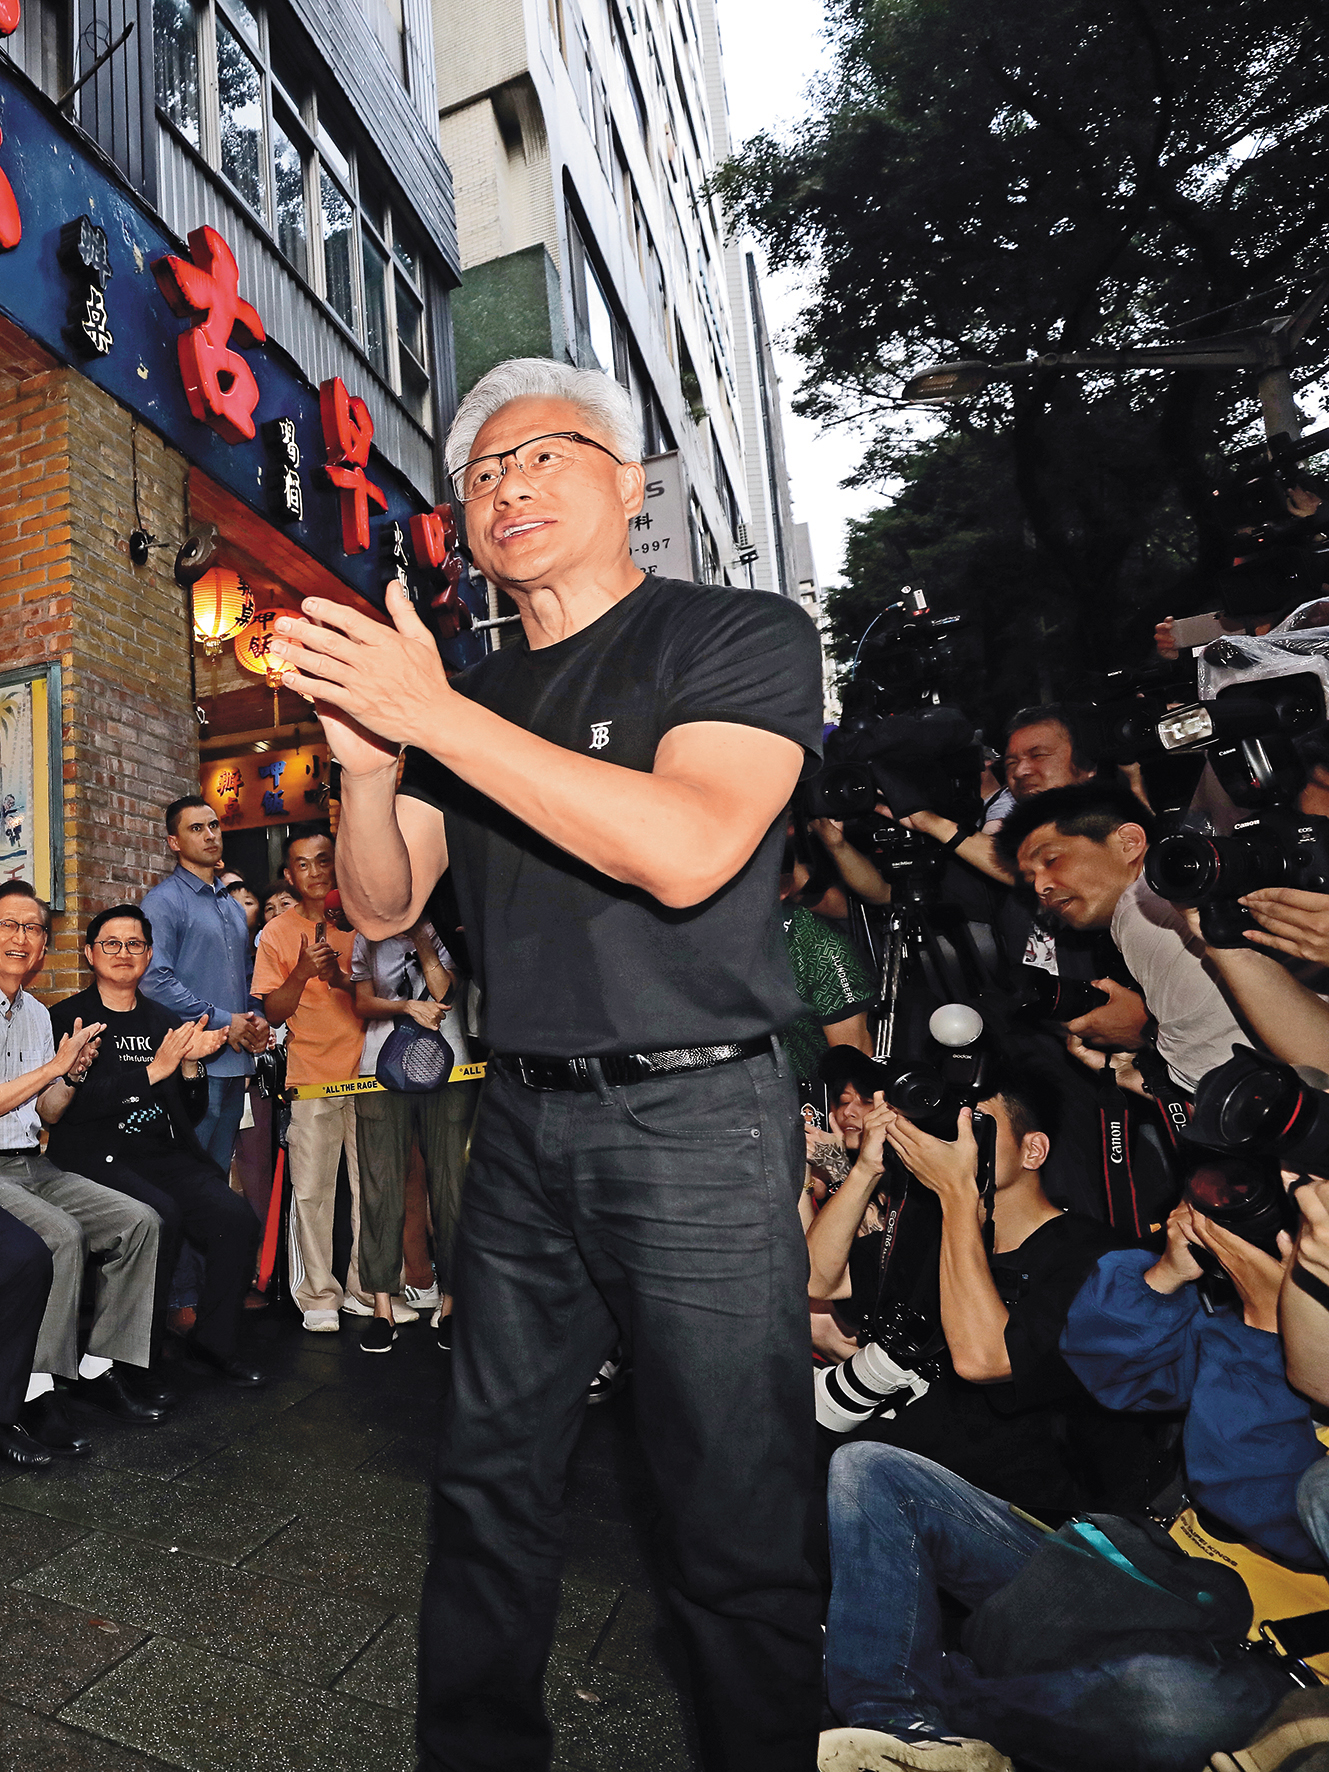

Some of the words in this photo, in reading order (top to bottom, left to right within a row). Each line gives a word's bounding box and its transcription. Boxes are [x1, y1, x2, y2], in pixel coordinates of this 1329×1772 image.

[629, 512, 654, 532] 科
[1234, 819, 1260, 830] Canon
[831, 954, 855, 1004] J.LINDEBERG
[340, 1083, 356, 1092] THE
[356, 1080, 378, 1090] RAGE
[1110, 1121, 1123, 1164] Canon
[887, 1210, 897, 1234] EOS
[884, 1233, 893, 1247] R6
[1187, 1525, 1208, 1546] TAIPEI
[1207, 1545, 1238, 1567] KINGS
